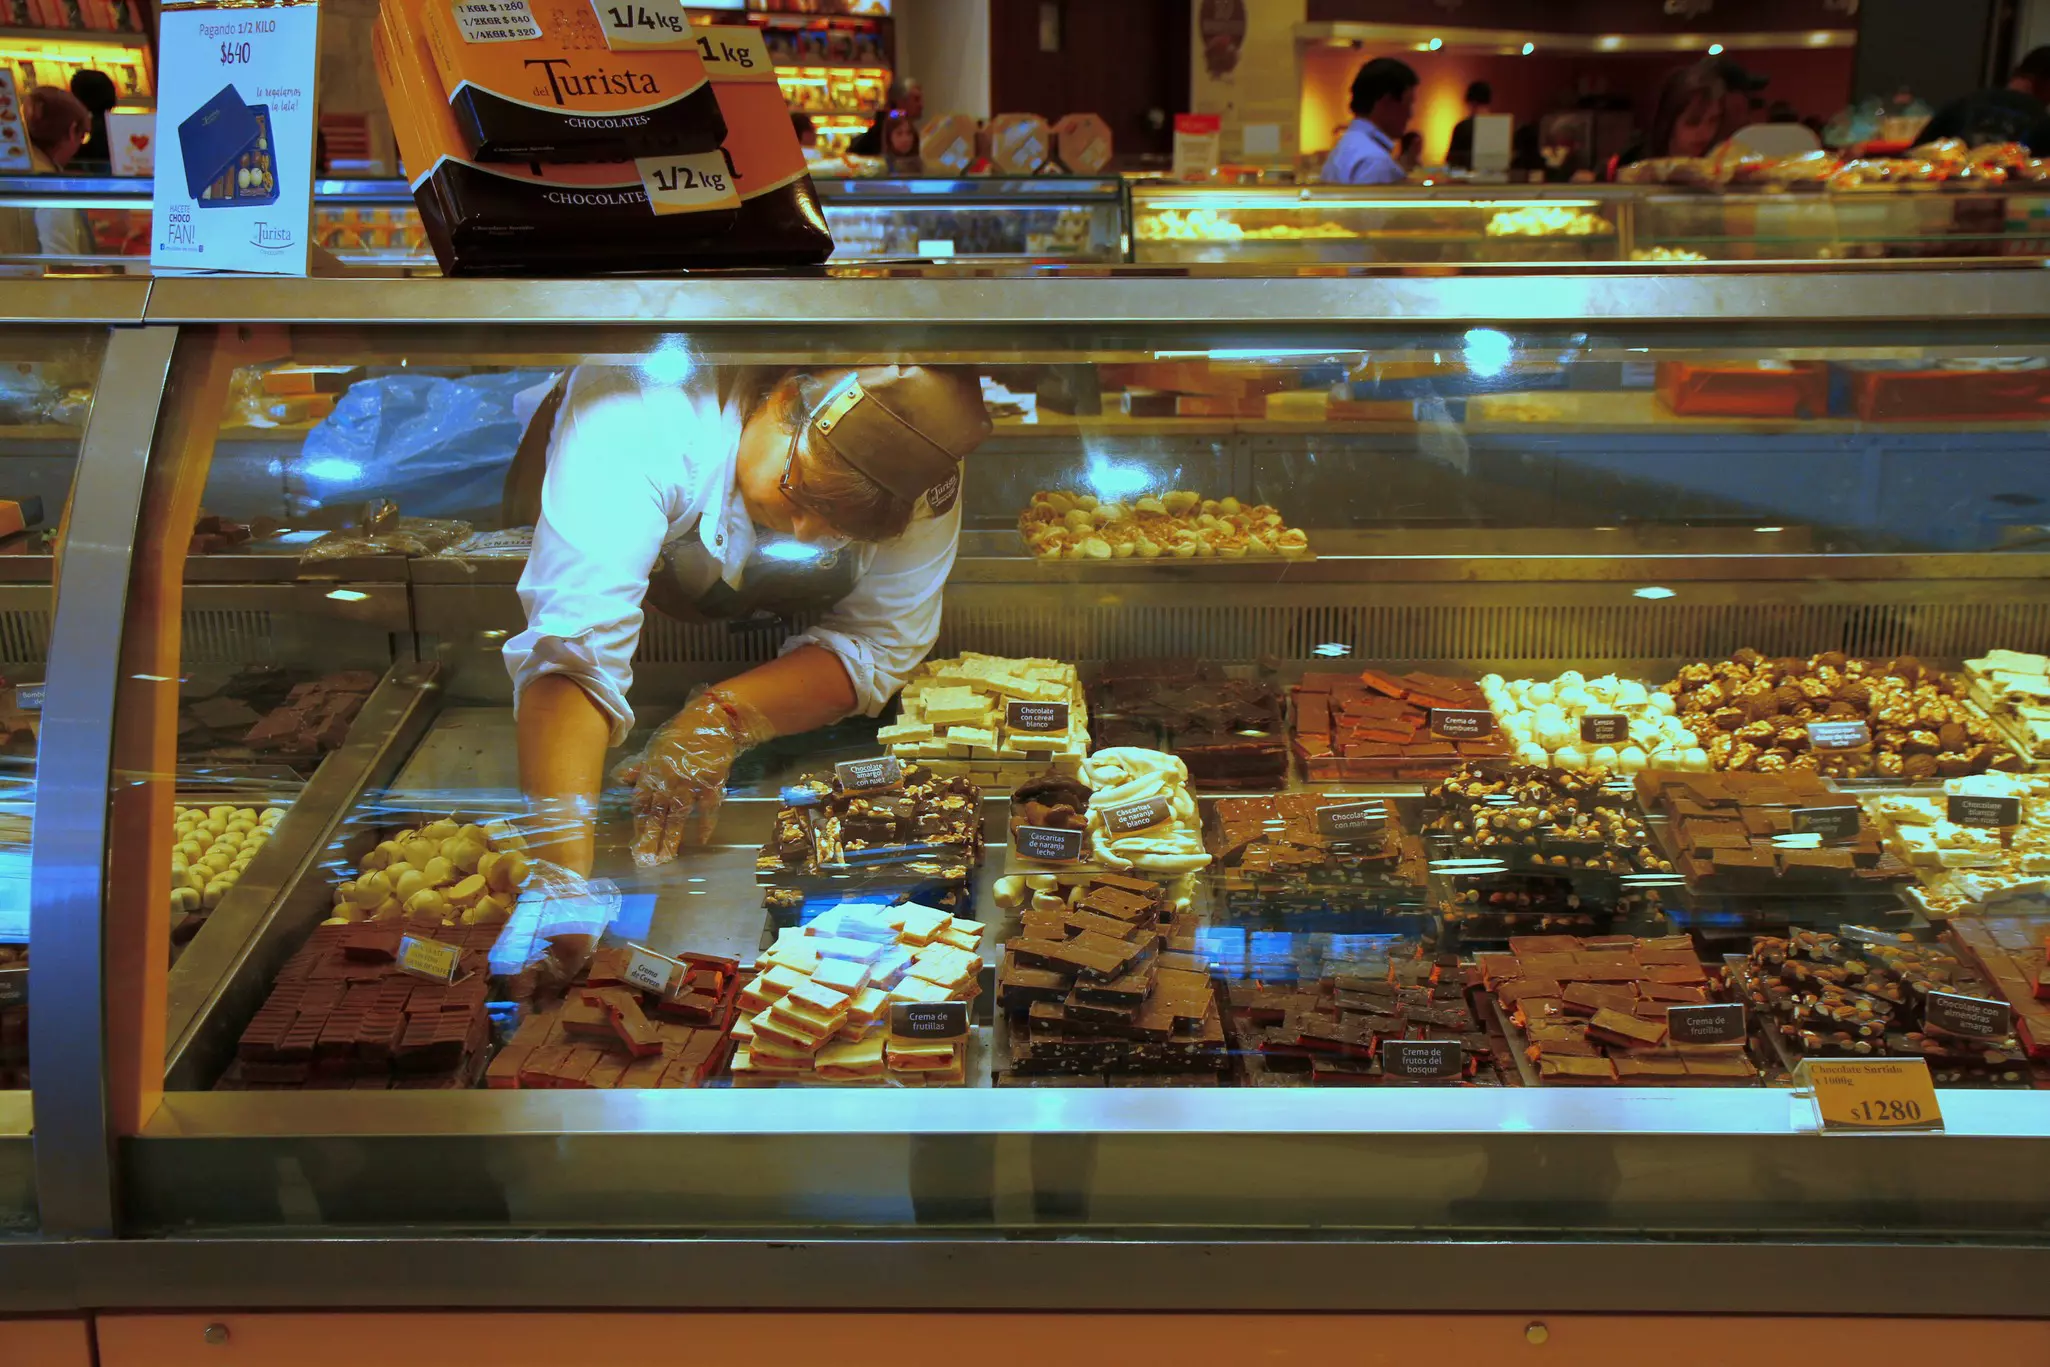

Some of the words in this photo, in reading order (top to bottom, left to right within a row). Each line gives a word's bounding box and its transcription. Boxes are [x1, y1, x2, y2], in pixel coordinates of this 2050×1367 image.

[466, 4, 488, 13] KGR
[490, 3, 496, 12] $
[499, 1, 524, 11] 1280
[463, 16, 502, 27] 1/2KGR
[503, 15, 509, 25] $
[511, 15, 530, 24] 640
[608, 5, 655, 30] 1/4
[655, 12, 684, 33] kg
[199, 23, 235, 39] Pagando
[238, 21, 253, 34] 1/2
[255, 20, 276, 33] KILO
[468, 30, 508, 39] 1/4KGR
[509, 29, 516, 38] $
[517, 28, 536, 37] 320
[220, 41, 251, 66] $640
[696, 36, 720, 61] 1
[720, 42, 754, 68] kg
[524, 59, 660, 105] Turista
[265, 85, 301, 99] regalamos
[532, 86, 550, 97] del
[568, 115, 648, 129] CHOCOLATES
[652, 166, 698, 192] 1/2
[698, 170, 726, 192] kg
[169, 204, 191, 213] HACETE
[169, 213, 191, 223] CHOCO
[168, 224, 195, 245] FAN!
[254, 221, 291, 244] Turista
[1020, 707, 1054, 715] Chocolate
[1445, 716, 1467, 725] Crema
[1443, 724, 1479, 732] frambuesa
[850, 763, 883, 773] Chocolate
[856, 770, 882, 779] amargo
[856, 779, 869, 787] con
[1116, 804, 1151, 817] Cascaritas
[1332, 811, 1369, 821] Chocolate
[1118, 816, 1127, 824] de
[1128, 809, 1154, 822] naranja
[1126, 817, 1150, 828] blanco
[1030, 832, 1065, 843] Cascaritas
[1028, 840, 1039, 848] de
[1039, 841, 1065, 850] naranja
[1036, 848, 1055, 856] leche
[631, 970, 640, 979] de
[638, 964, 658, 978] Crema
[1937, 998, 1981, 1013] Chocolate
[1982, 1007, 1999, 1016] con
[909, 1012, 936, 1021] Crema
[937, 1012, 948, 1021] de
[1686, 1017, 1713, 1026] Crema
[1714, 1016, 1725, 1025] de
[1943, 1009, 1990, 1023] almendras
[912, 1022, 945, 1031] frutillas
[1690, 1026, 1723, 1036] frutillas
[1960, 1020, 1993, 1034] amargo
[1402, 1047, 1429, 1056] Crema
[1430, 1047, 1442, 1056] de
[1402, 1056, 1427, 1065] frutos
[1428, 1056, 1442, 1065] del
[1407, 1065, 1438, 1076] bosque
[1811, 1064, 1861, 1074] Chocolate
[1863, 1064, 1903, 1074] Surtido
[1823, 1076, 1854, 1086] 1000g
[1850, 1099, 1921, 1121] $1280
